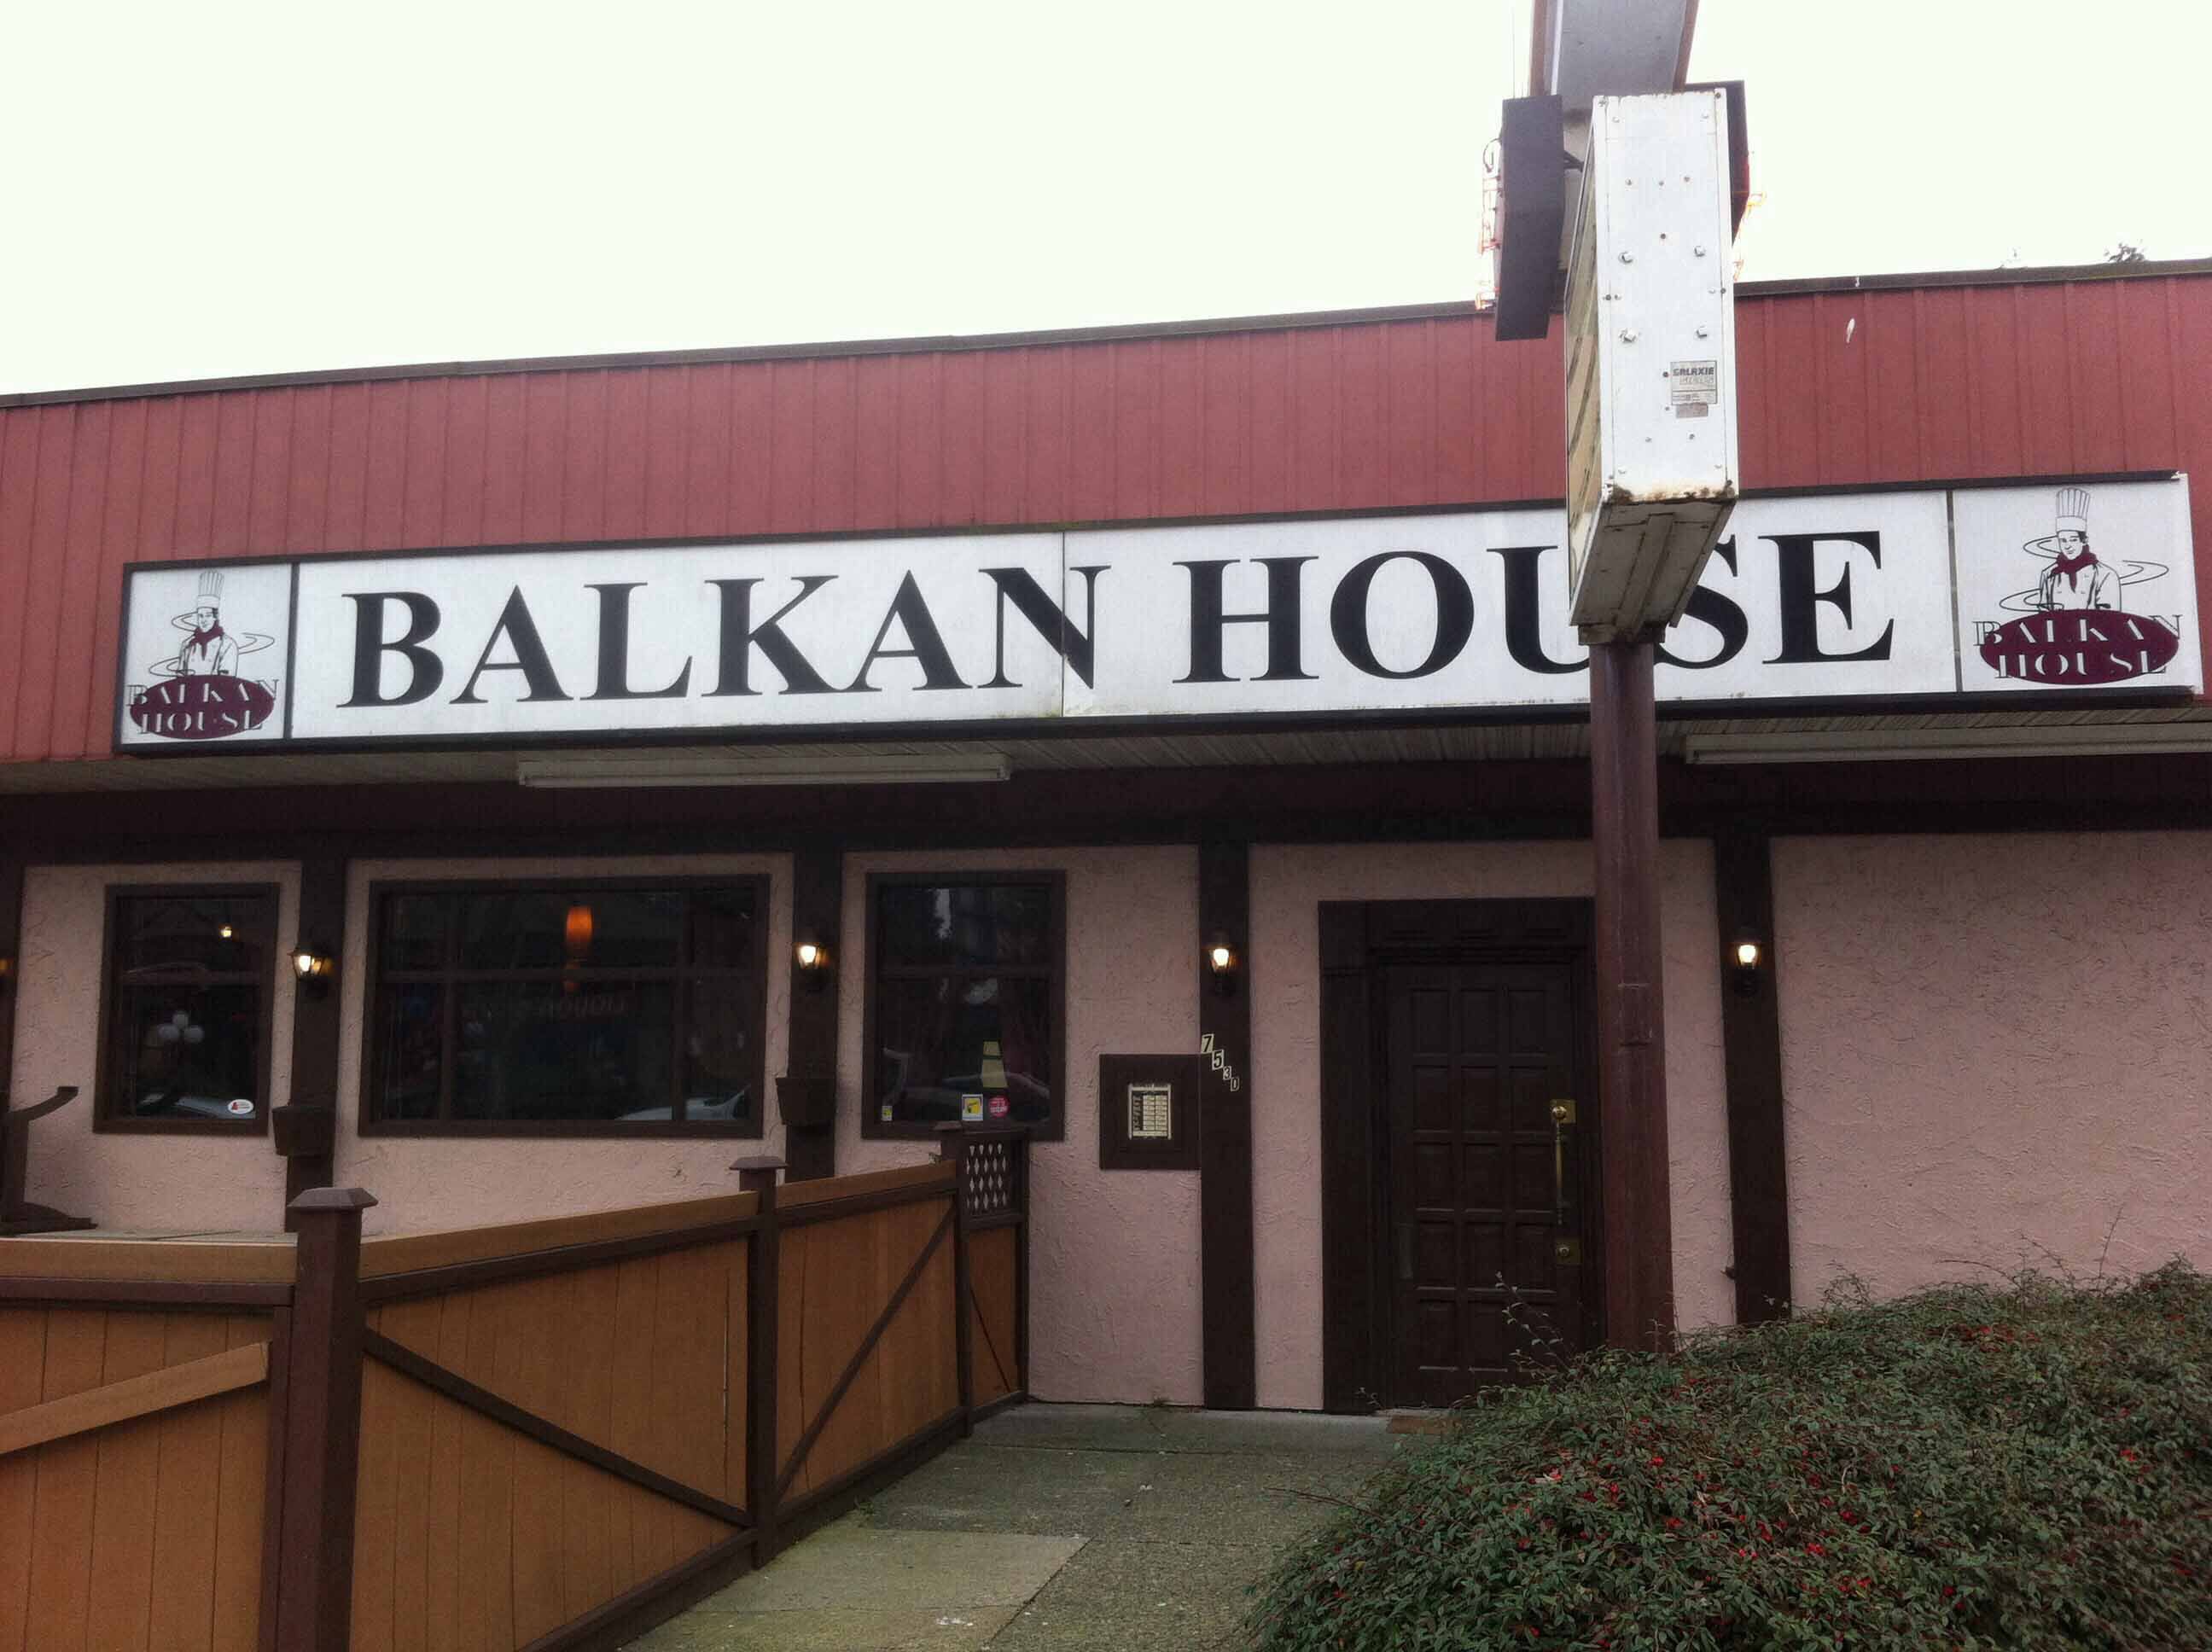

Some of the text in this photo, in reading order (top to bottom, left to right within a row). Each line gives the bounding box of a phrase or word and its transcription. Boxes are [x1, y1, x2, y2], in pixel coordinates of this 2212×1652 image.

[336, 531, 1895, 708] BALKAN HOUSE
[1972, 614, 2183, 646] BALKAN
[1994, 650, 2167, 679] HOUSE
[125, 678, 280, 707] BALKAN
[137, 709, 263, 735] HOUSE
